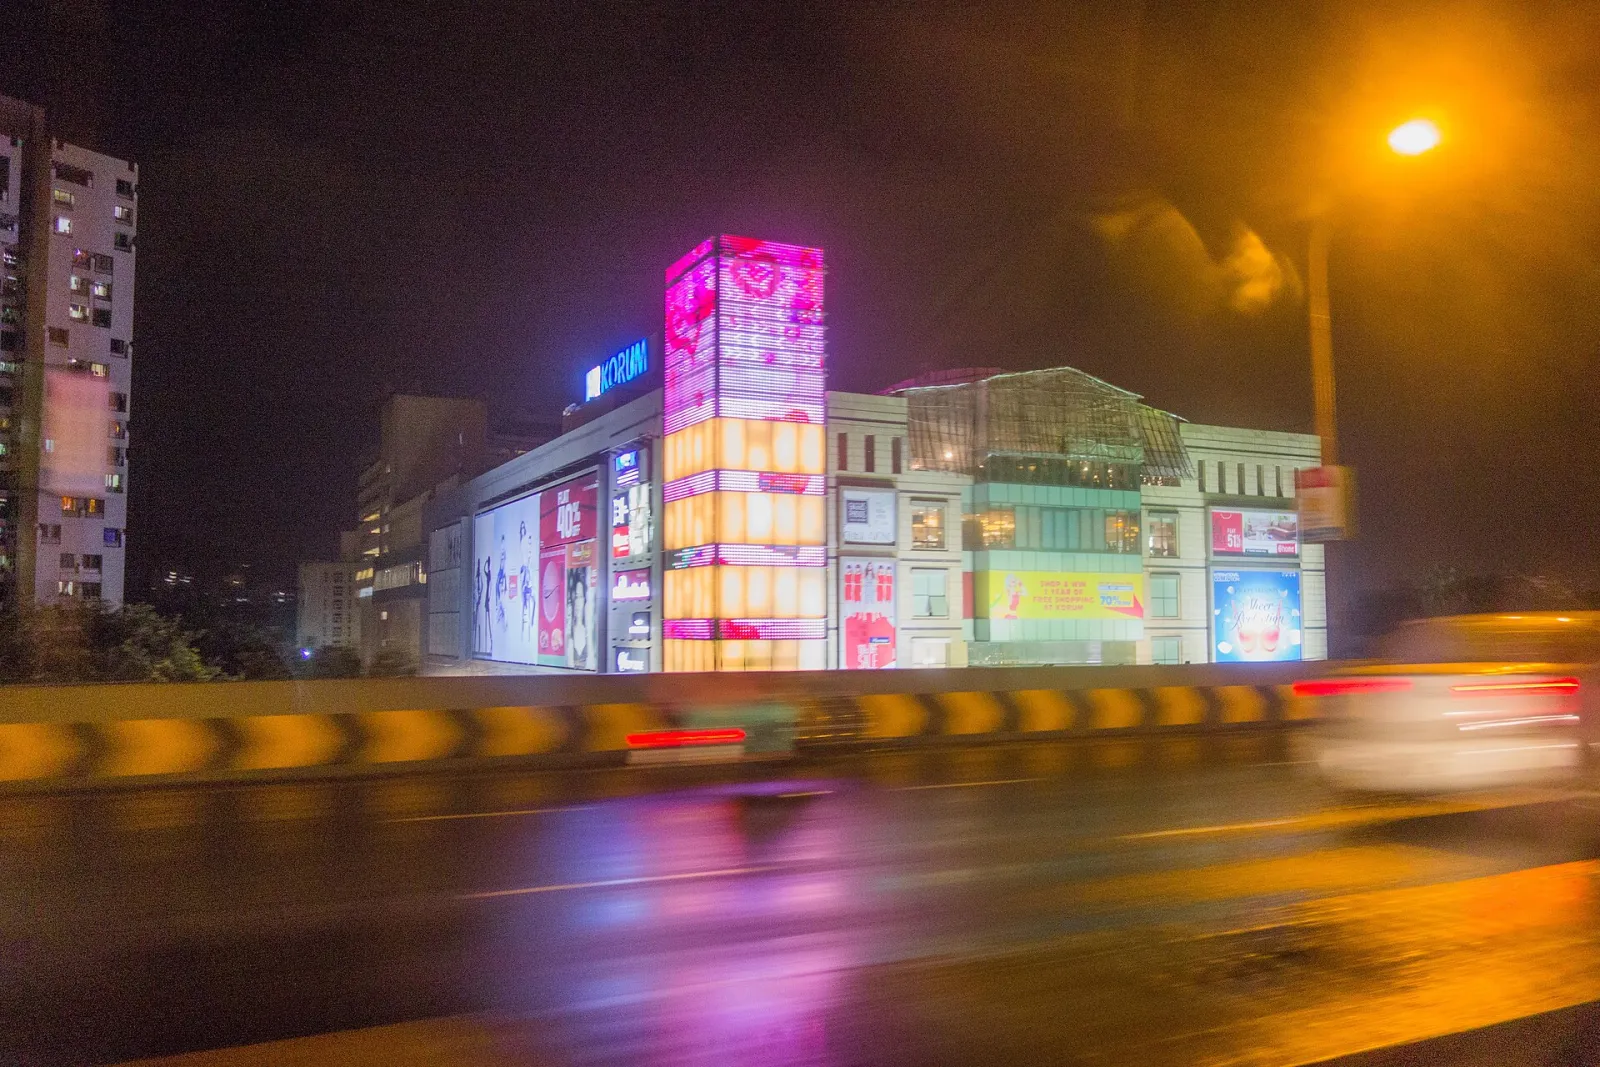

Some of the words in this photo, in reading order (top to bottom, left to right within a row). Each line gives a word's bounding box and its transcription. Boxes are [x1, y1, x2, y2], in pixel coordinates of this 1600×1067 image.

[601, 338, 648, 394] KORUM
[557, 501, 581, 539] 40%
[1227, 610, 1285, 630] Perfction
